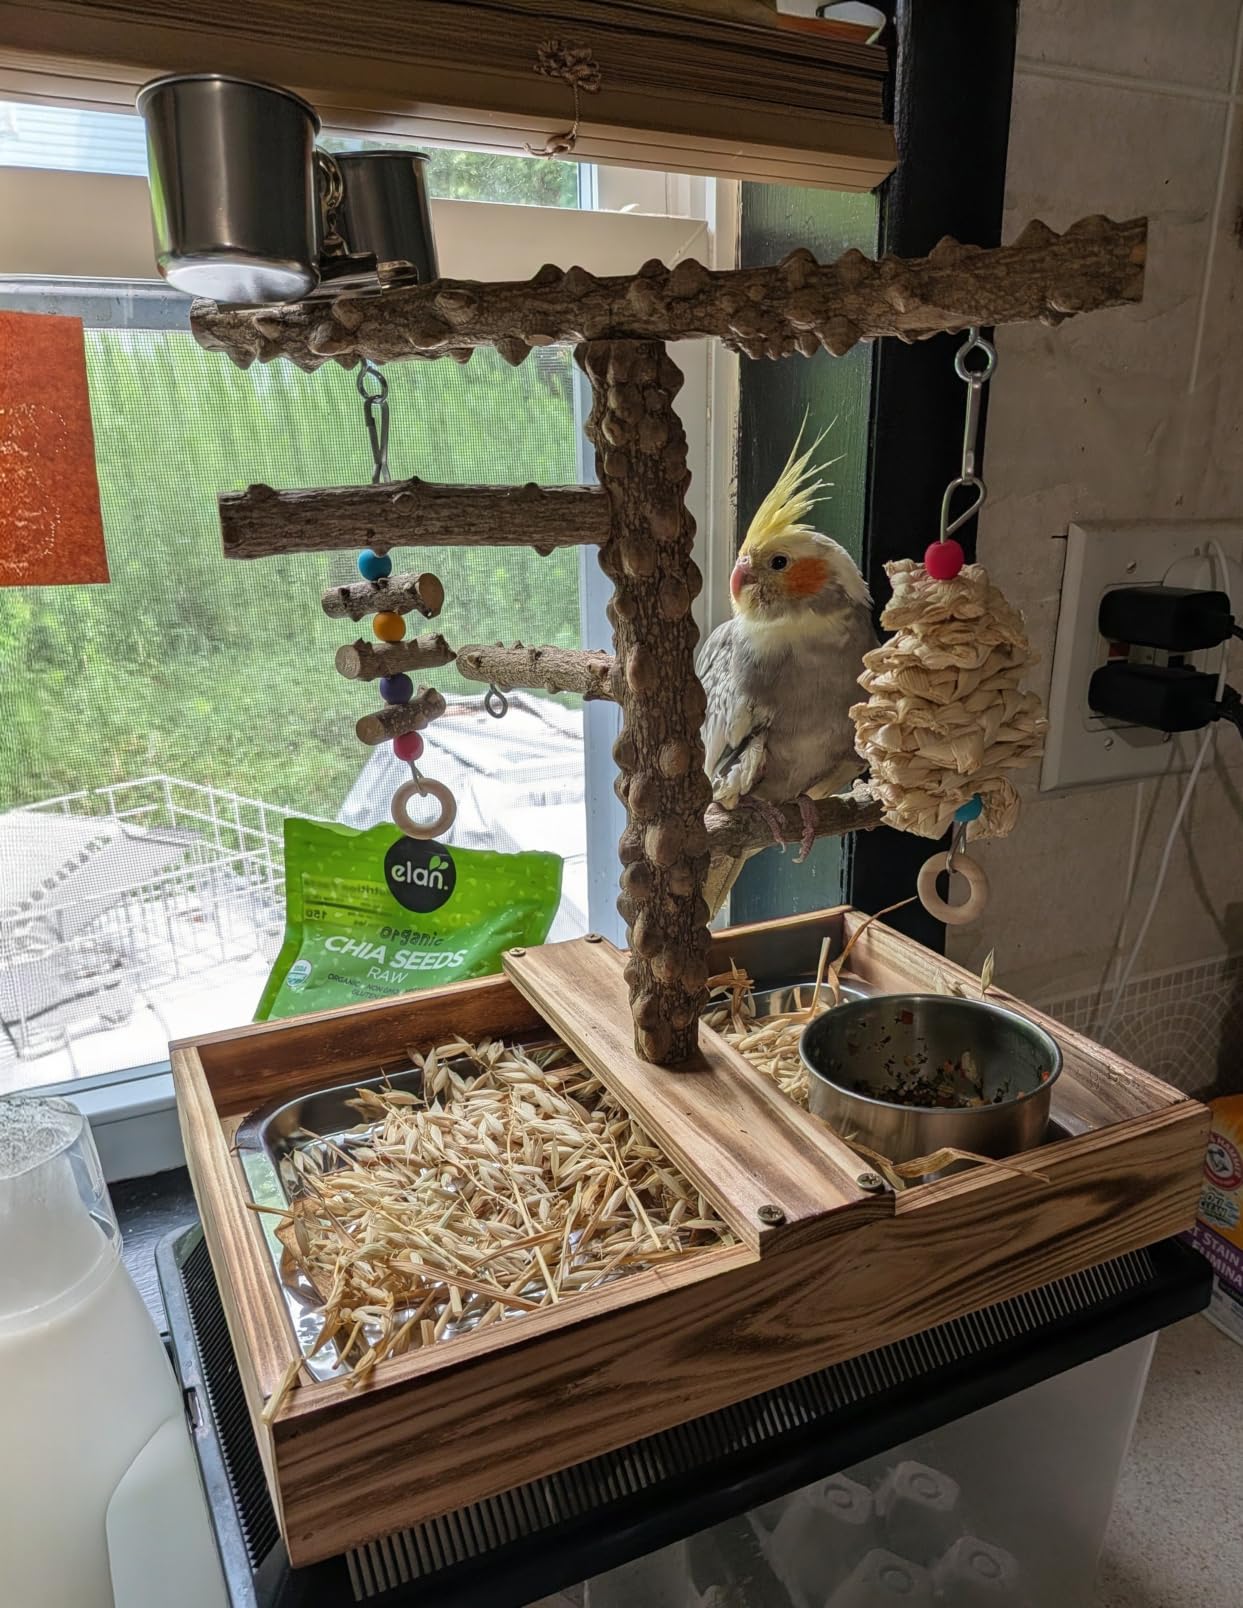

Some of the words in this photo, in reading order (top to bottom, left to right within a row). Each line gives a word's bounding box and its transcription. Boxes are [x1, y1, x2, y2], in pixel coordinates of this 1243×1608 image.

[379, 926, 443, 947] organic
[324, 936, 387, 964] CHIA
[389, 949, 468, 971] SEEDS
[327, 973, 361, 988] ORGANIC
[366, 966, 409, 984] RAW
[1202, 1232, 1240, 1267] STAIN
